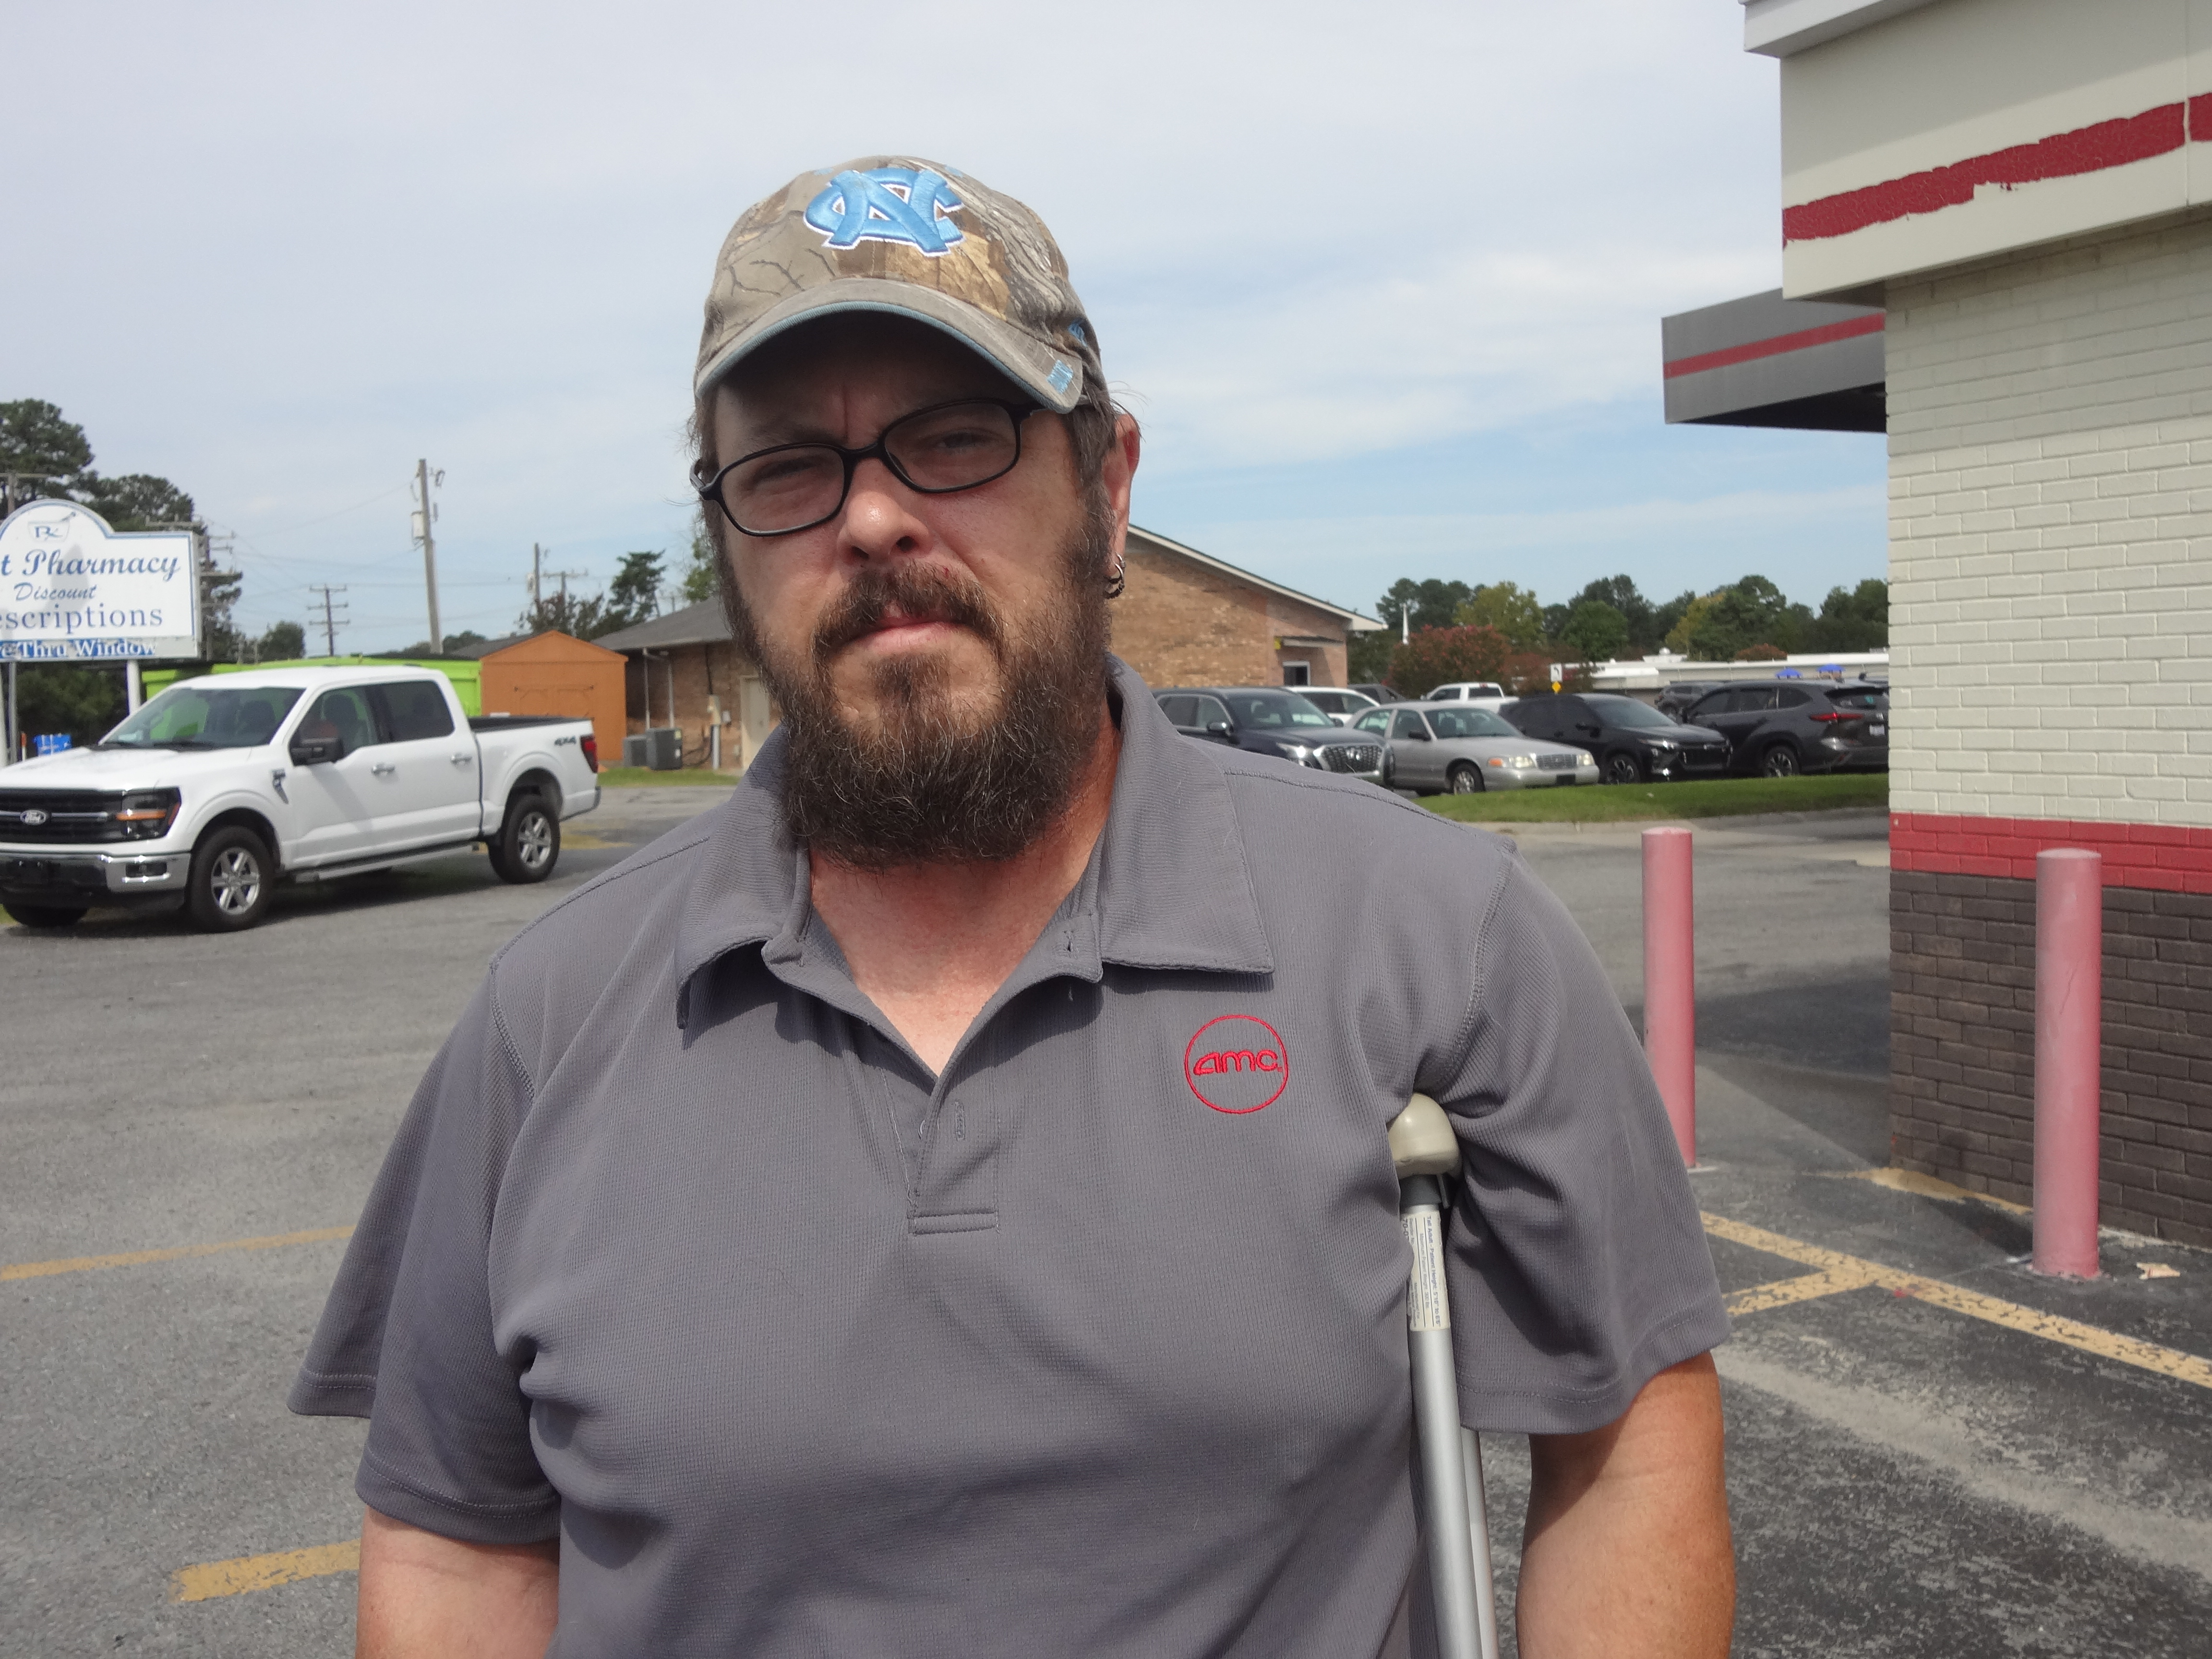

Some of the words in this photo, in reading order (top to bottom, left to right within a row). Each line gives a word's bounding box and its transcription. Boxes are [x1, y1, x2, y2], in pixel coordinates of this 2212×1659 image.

[22, 548, 180, 582] Pharmacy
[13, 582, 97, 601] Discount
[0, 603, 163, 635] scriptions
[17, 640, 68, 658] Thru
[74, 637, 157, 657] Window
